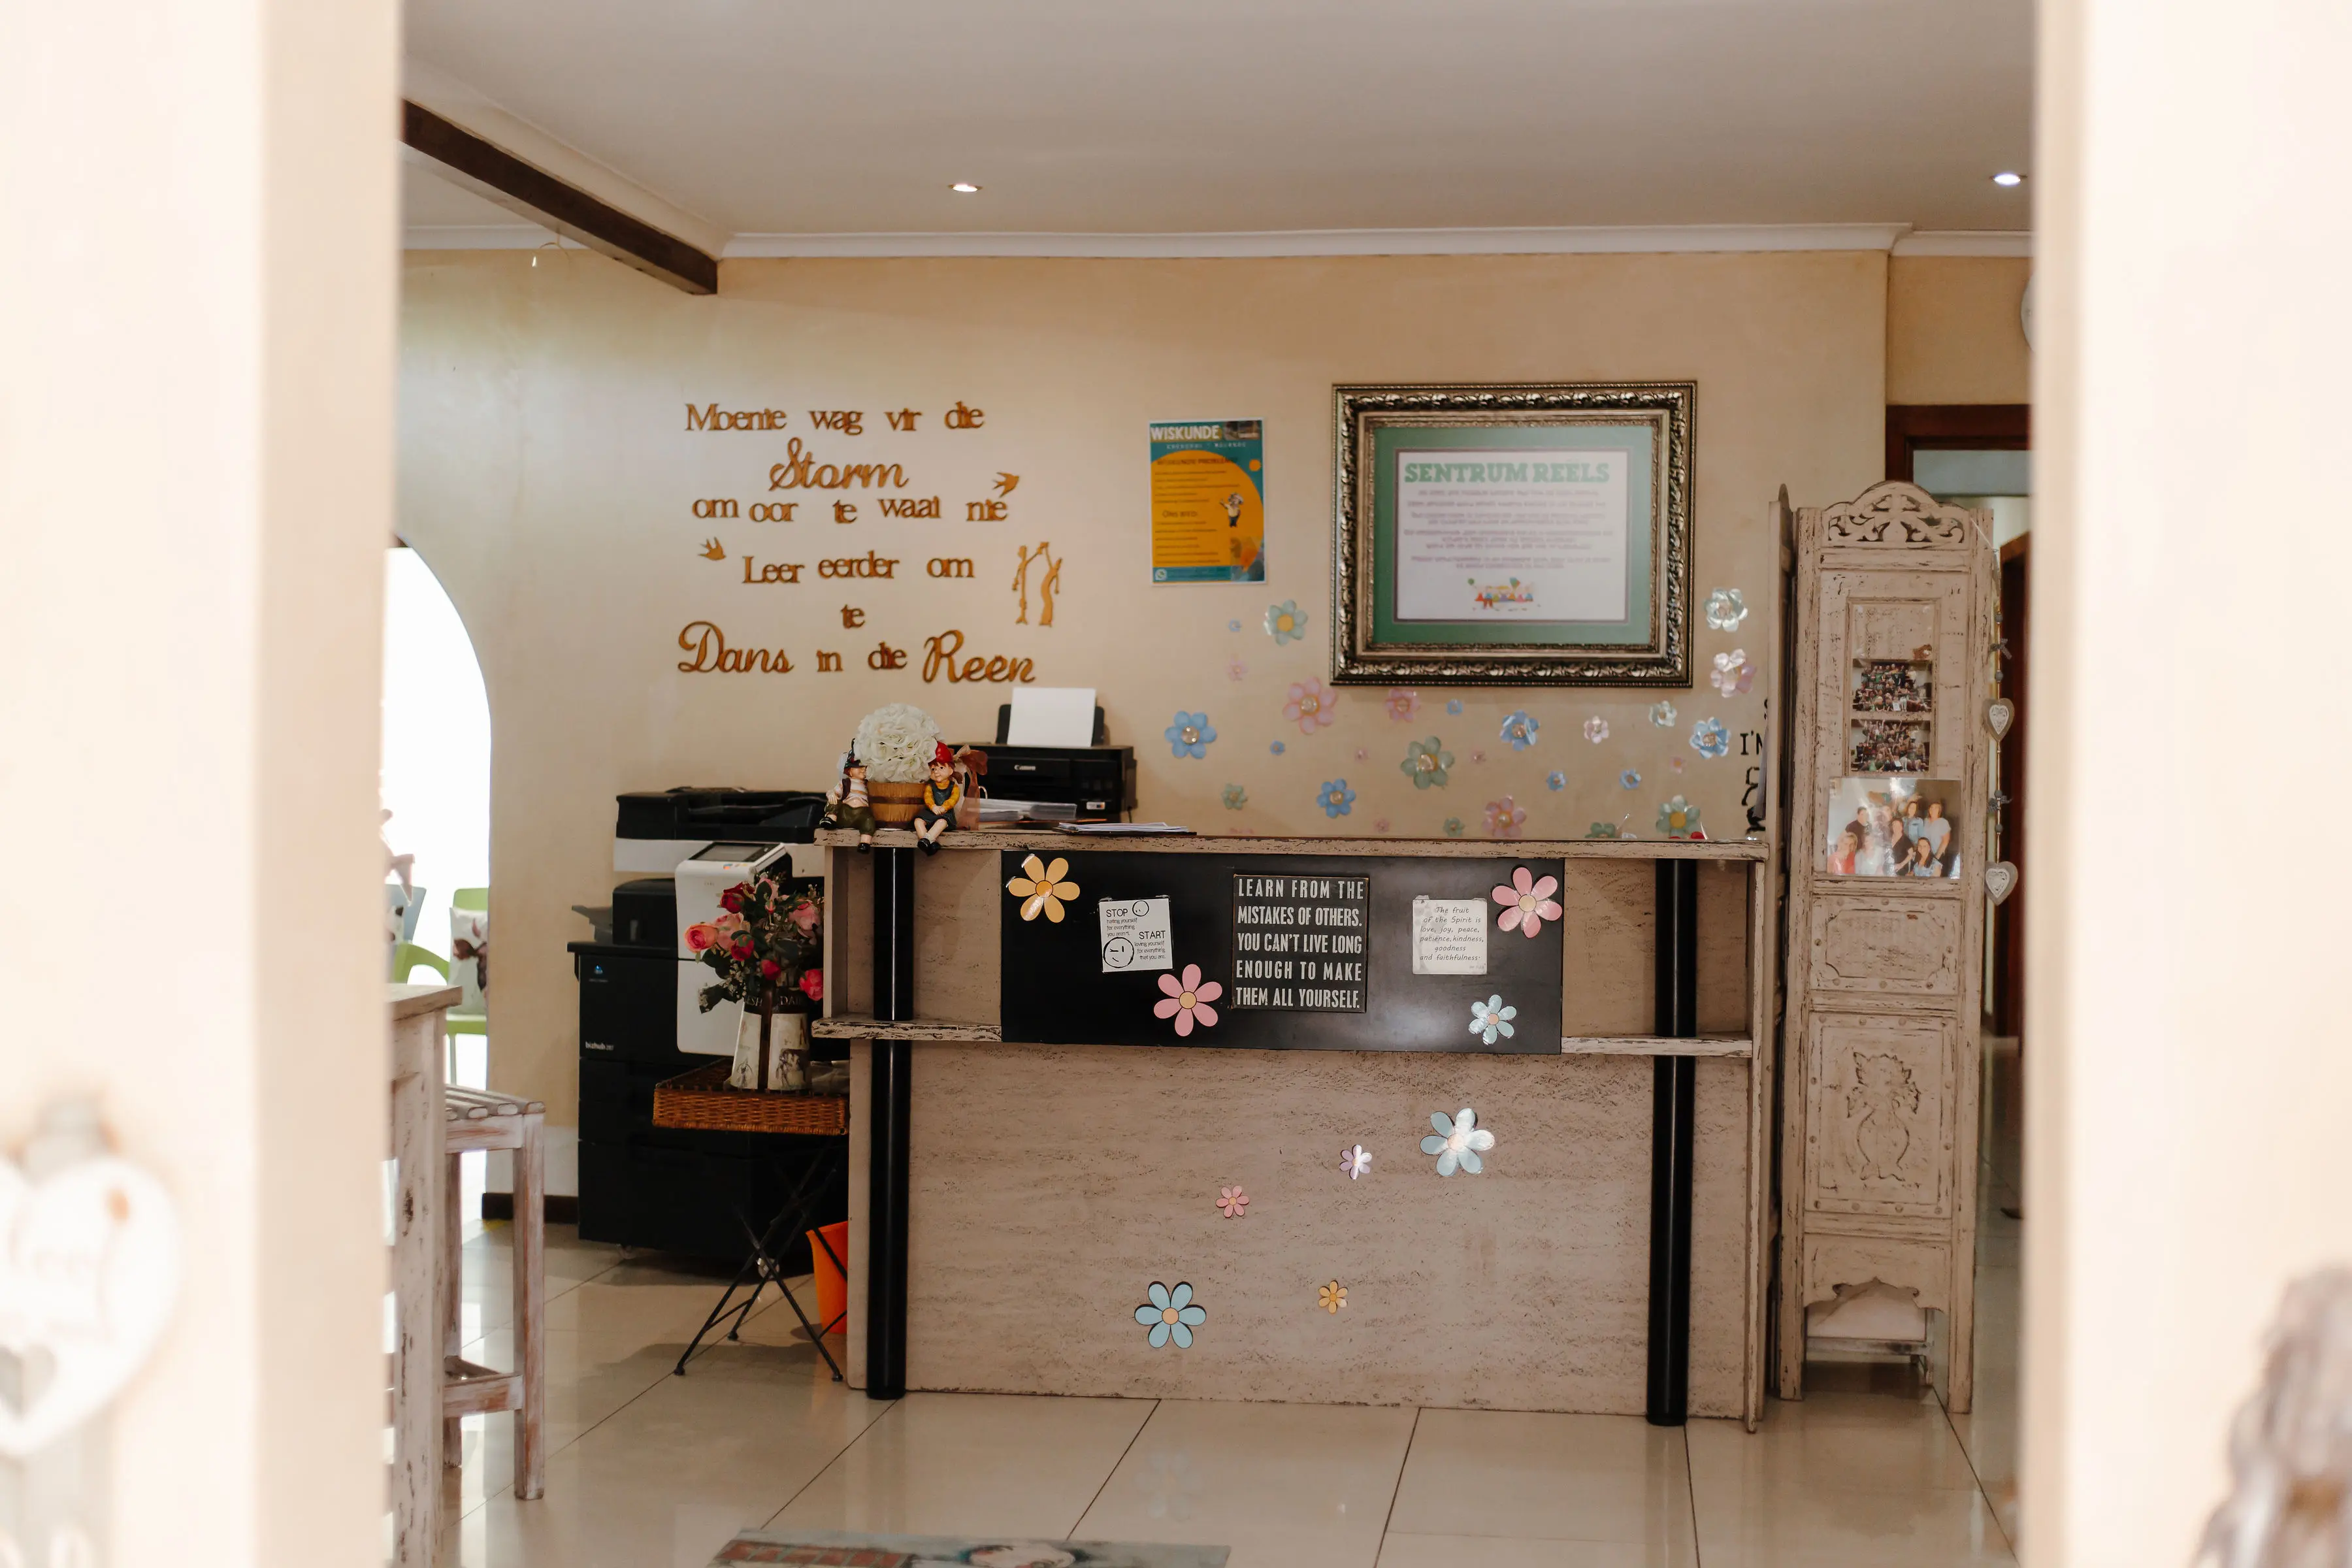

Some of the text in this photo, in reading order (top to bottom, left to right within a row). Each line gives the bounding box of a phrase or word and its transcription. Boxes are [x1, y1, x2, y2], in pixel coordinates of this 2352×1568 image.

[685, 401, 985, 435] Moenie wag vir die
[1151, 425, 1220, 440] WISKUNDE
[768, 436, 909, 491] Storm
[1403, 462, 1610, 483] SENTRUM REELS
[692, 498, 739, 519] om
[749, 502, 799, 522] oor
[832, 499, 857, 523] te
[966, 498, 1008, 521] nie
[742, 550, 975, 584] Leer eerder om
[841, 604, 866, 629] te
[678, 621, 795, 673] Dans
[817, 649, 843, 672] in
[868, 642, 907, 670] die
[1239, 879, 1364, 899] LEARN FROM THE
[1237, 906, 1362, 926] MISTAKES OF OTHERS.
[1139, 930, 1166, 939] START
[1237, 933, 1362, 954] YOU CAN'T LIVE LONG
[1236, 960, 1362, 981] ENOUGH TO MAKE
[747, 995, 763, 1007] ESH
[1236, 988, 1360, 1008] THEM ALL YOURSELF.
